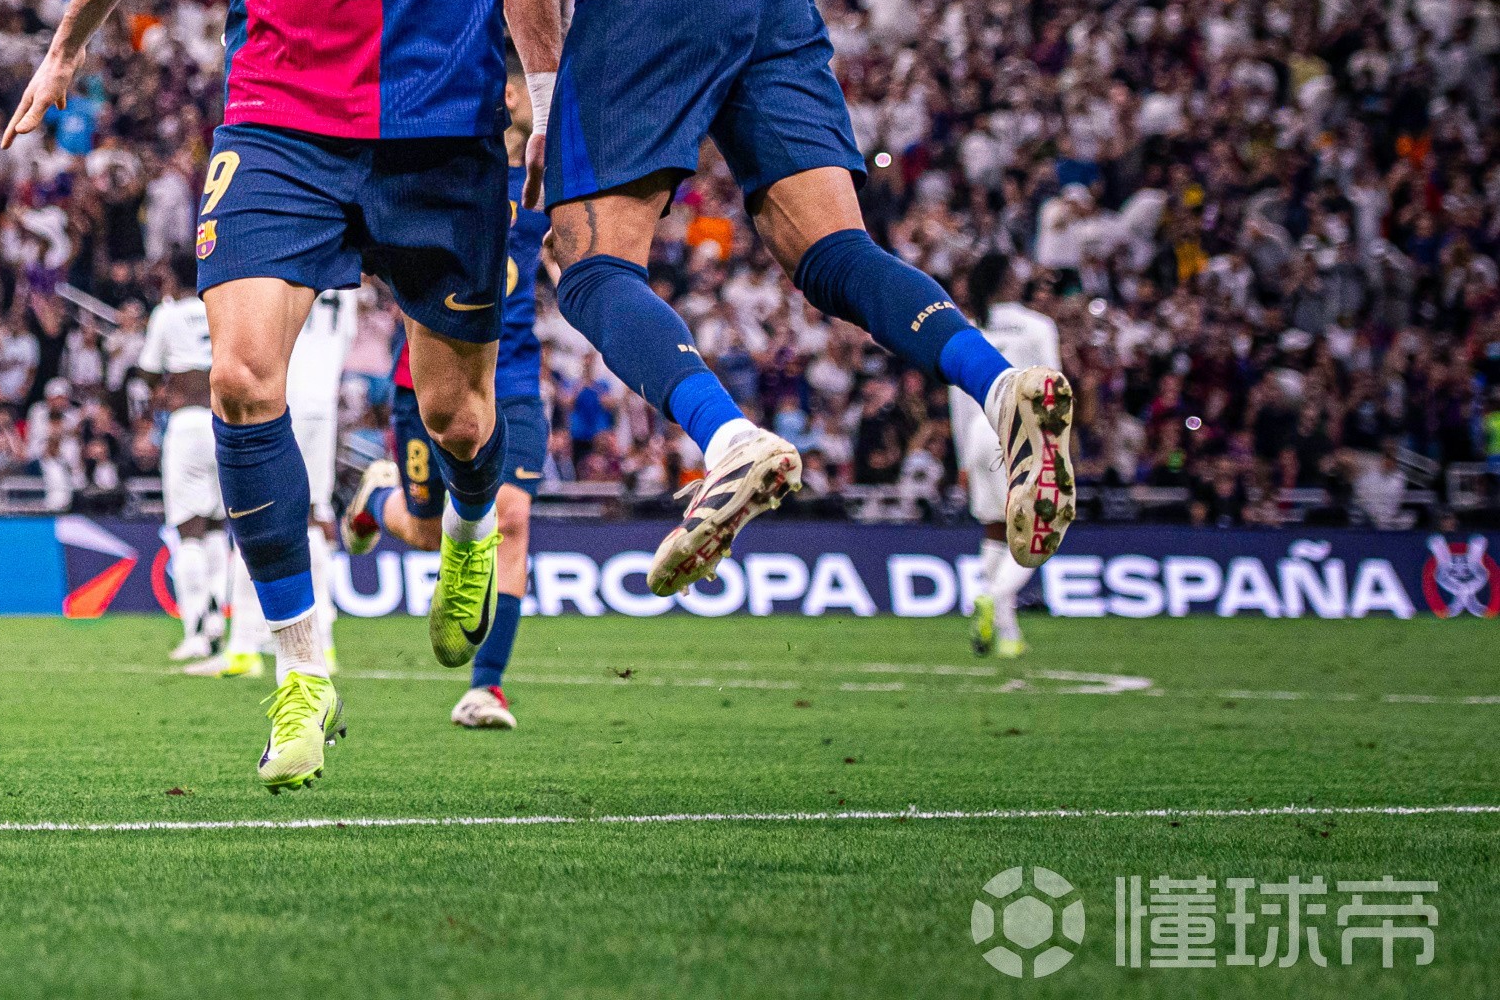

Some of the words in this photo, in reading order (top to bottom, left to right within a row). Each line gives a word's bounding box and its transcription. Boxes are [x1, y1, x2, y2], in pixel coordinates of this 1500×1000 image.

[201, 151, 241, 216] 9
[407, 439, 430, 483] 8
[331, 550, 876, 619] UPRCOPA
[1042, 539, 1416, 619] ESPAÑA
